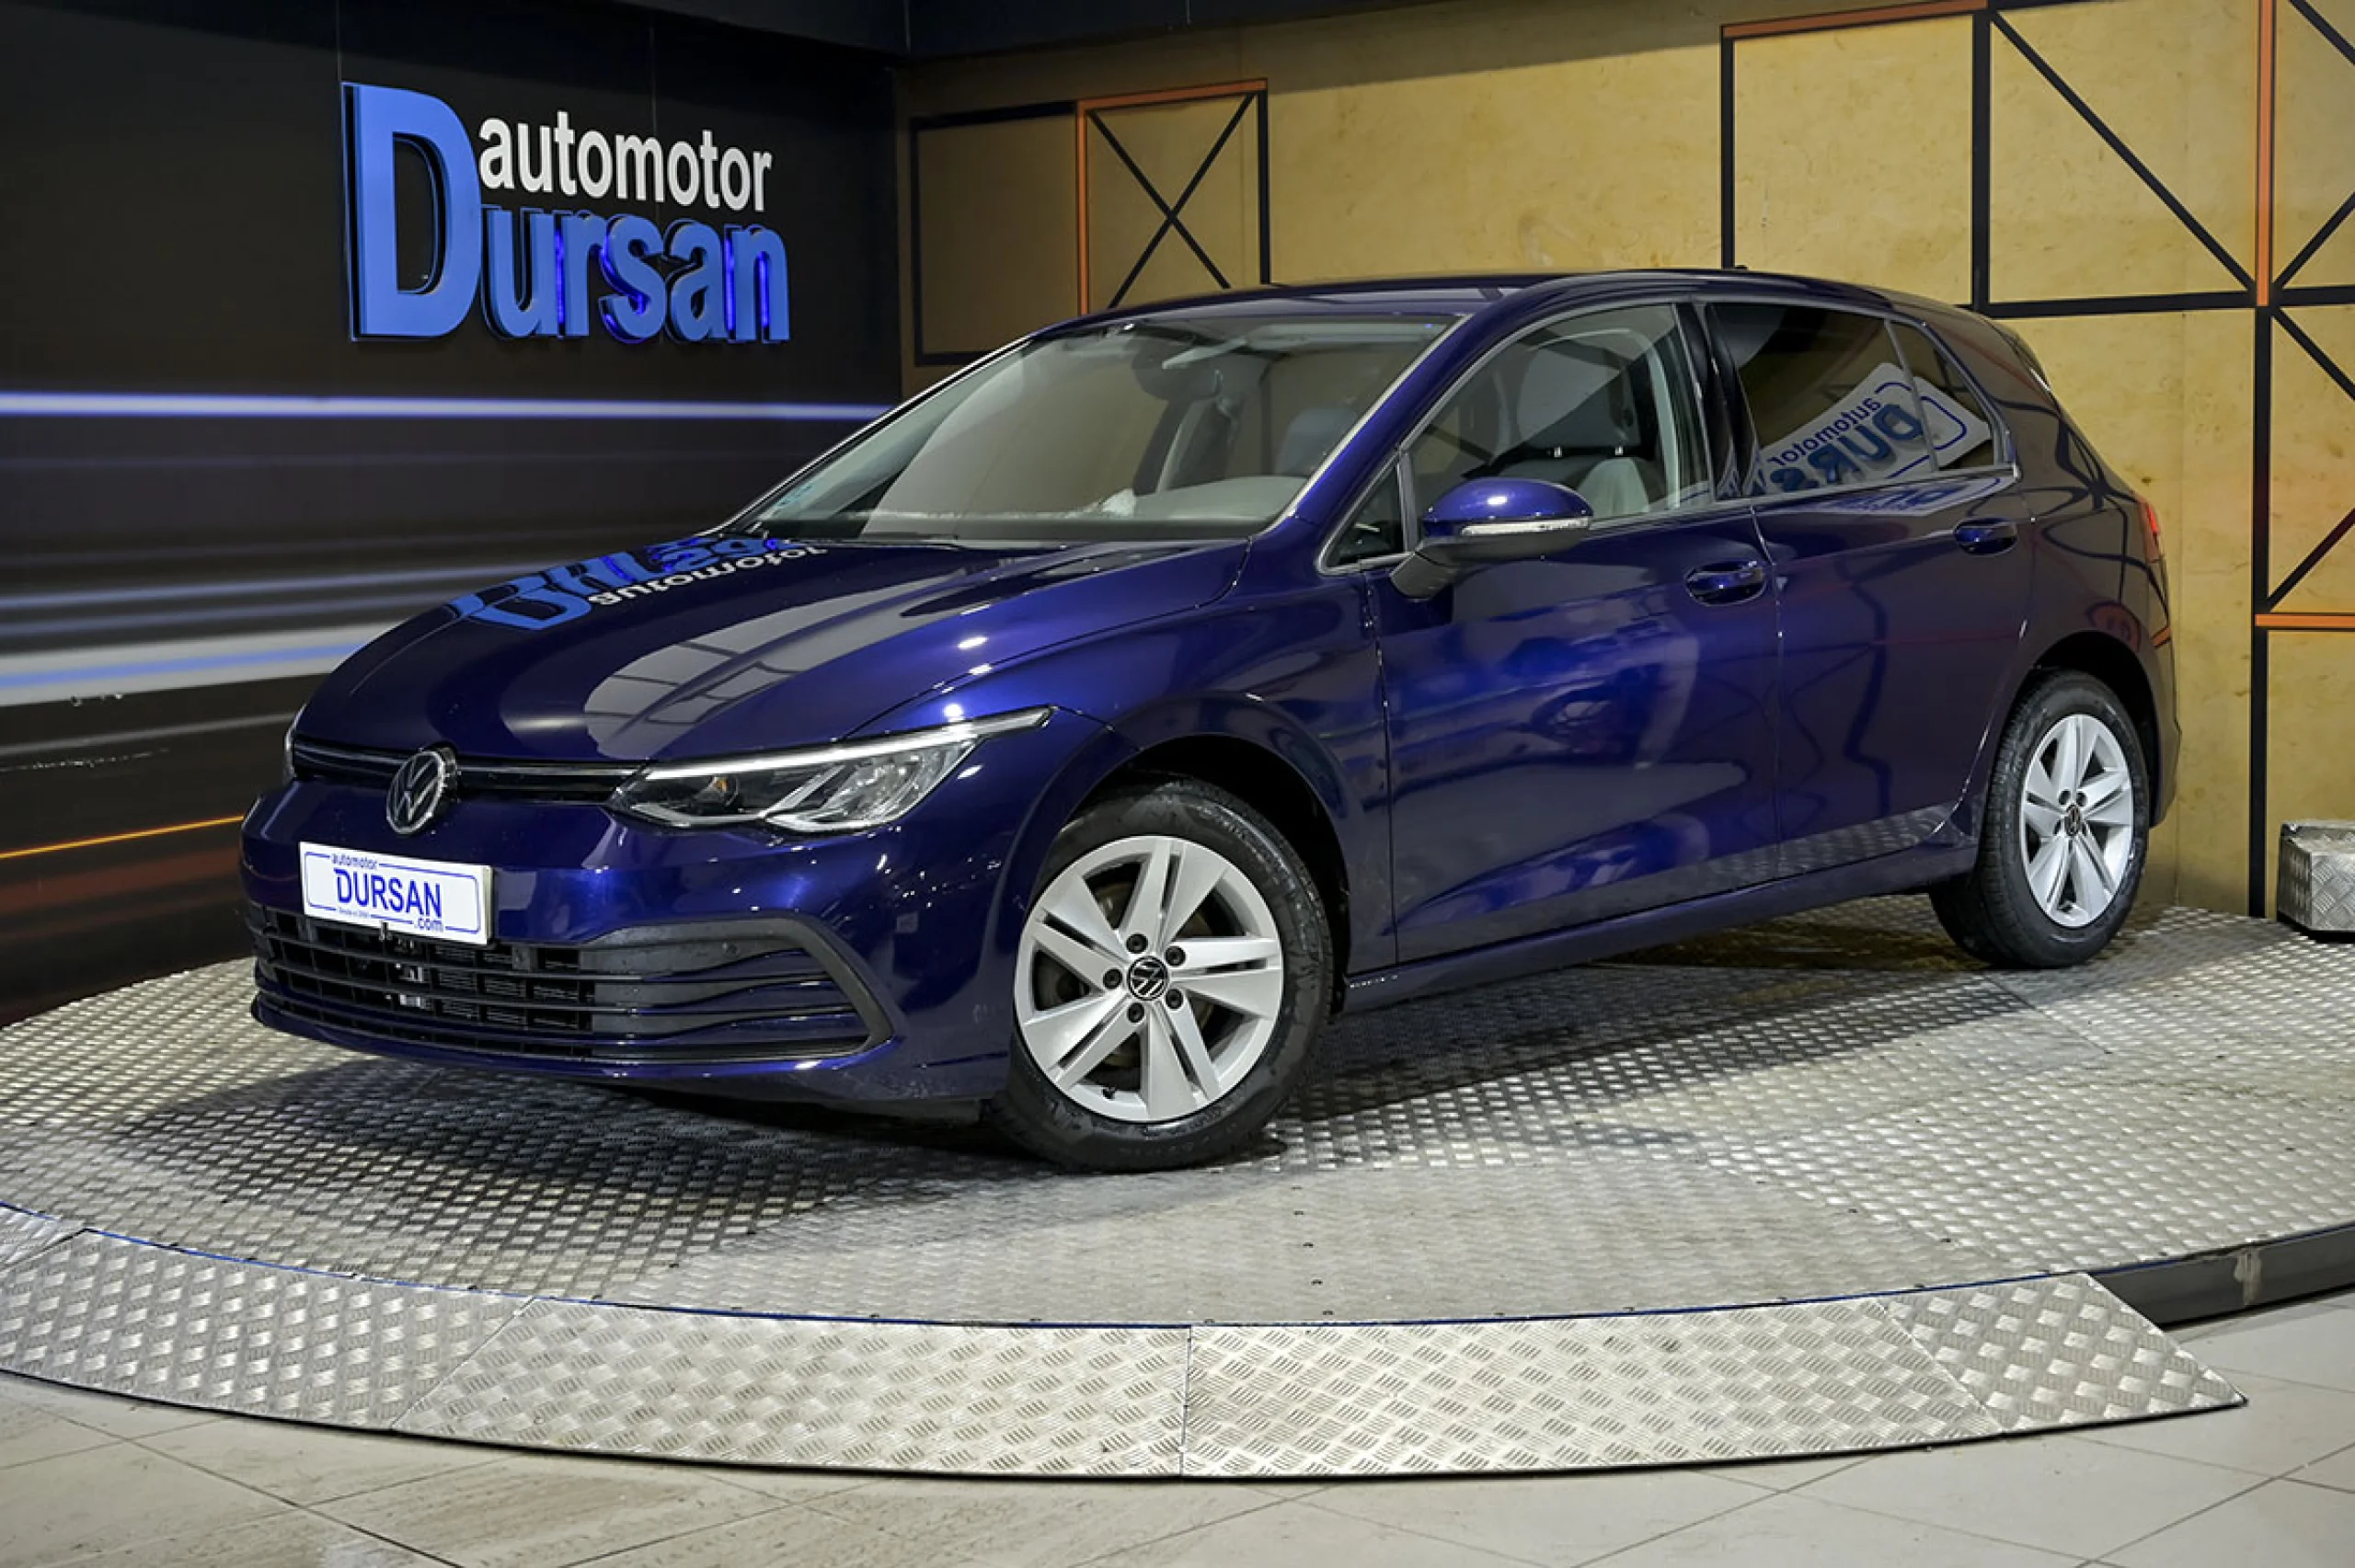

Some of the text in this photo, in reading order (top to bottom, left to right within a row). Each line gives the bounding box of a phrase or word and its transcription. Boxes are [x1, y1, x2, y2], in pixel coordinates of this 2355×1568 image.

[478, 109, 773, 211] automotor
[341, 81, 791, 343] Dursan
[331, 853, 378, 871] automotor
[333, 867, 442, 919] DURSAN
